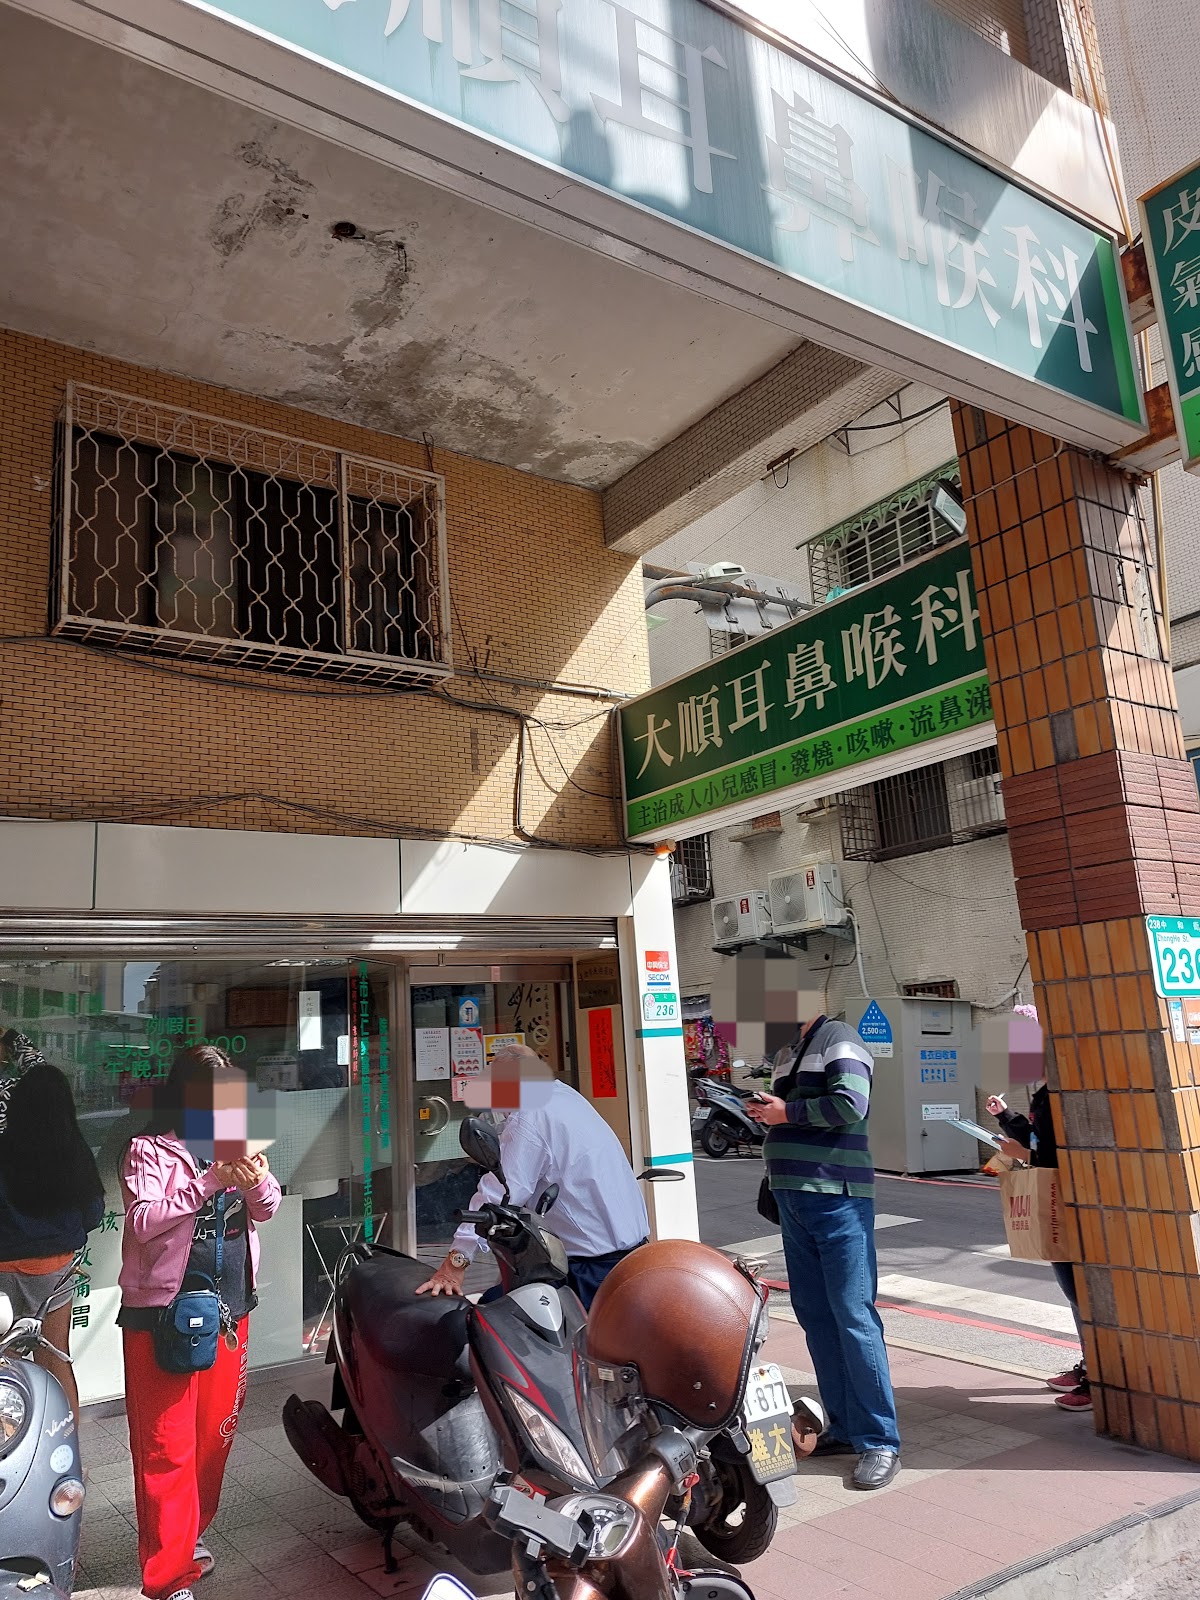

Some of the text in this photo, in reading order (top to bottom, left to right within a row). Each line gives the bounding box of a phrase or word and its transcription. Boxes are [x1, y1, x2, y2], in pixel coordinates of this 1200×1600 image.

[322, 0, 1098, 374] 順耳鼻喉科
[633, 569, 980, 780] 大順耳鼻喉科
[647, 973, 670, 981] SECOM
[656, 1004, 674, 1016] 236
[1009, 1194, 1031, 1219] MUJI
[1050, 1182, 1060, 1245] www.muji.tw
[72, 1304, 91, 1330] 胃
